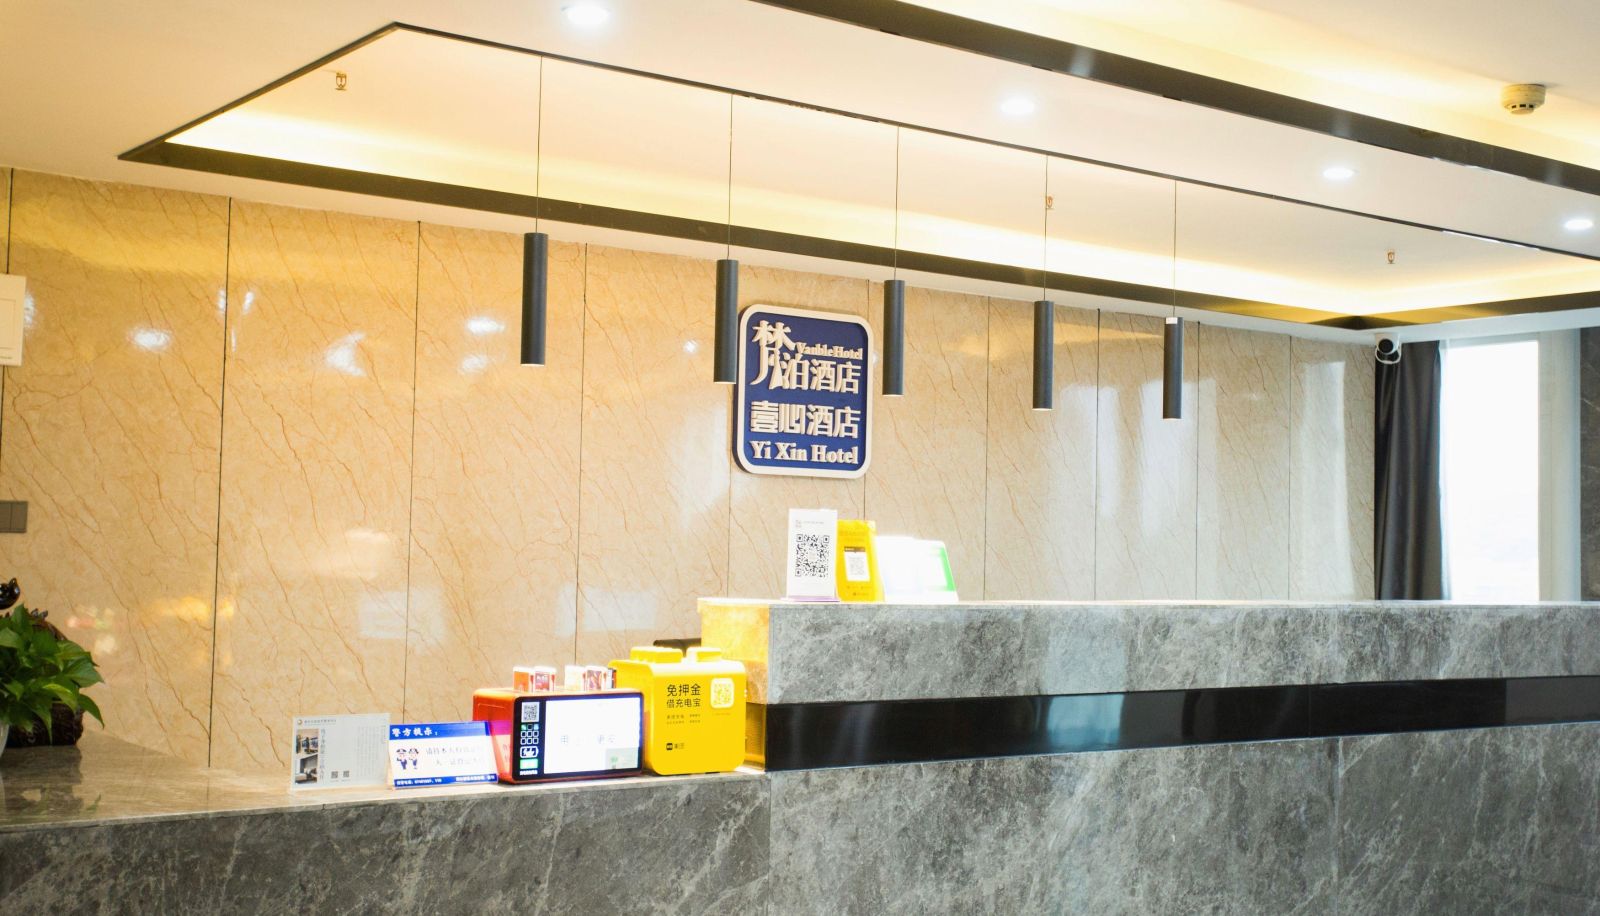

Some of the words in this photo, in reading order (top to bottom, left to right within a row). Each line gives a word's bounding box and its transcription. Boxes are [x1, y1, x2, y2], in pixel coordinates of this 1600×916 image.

[751, 440, 772, 460] Yi
[774, 442, 807, 461] Xin
[810, 444, 859, 464] Hotel
[667, 683, 701, 697] 免押金
[666, 698, 701, 709] 借充电宝
